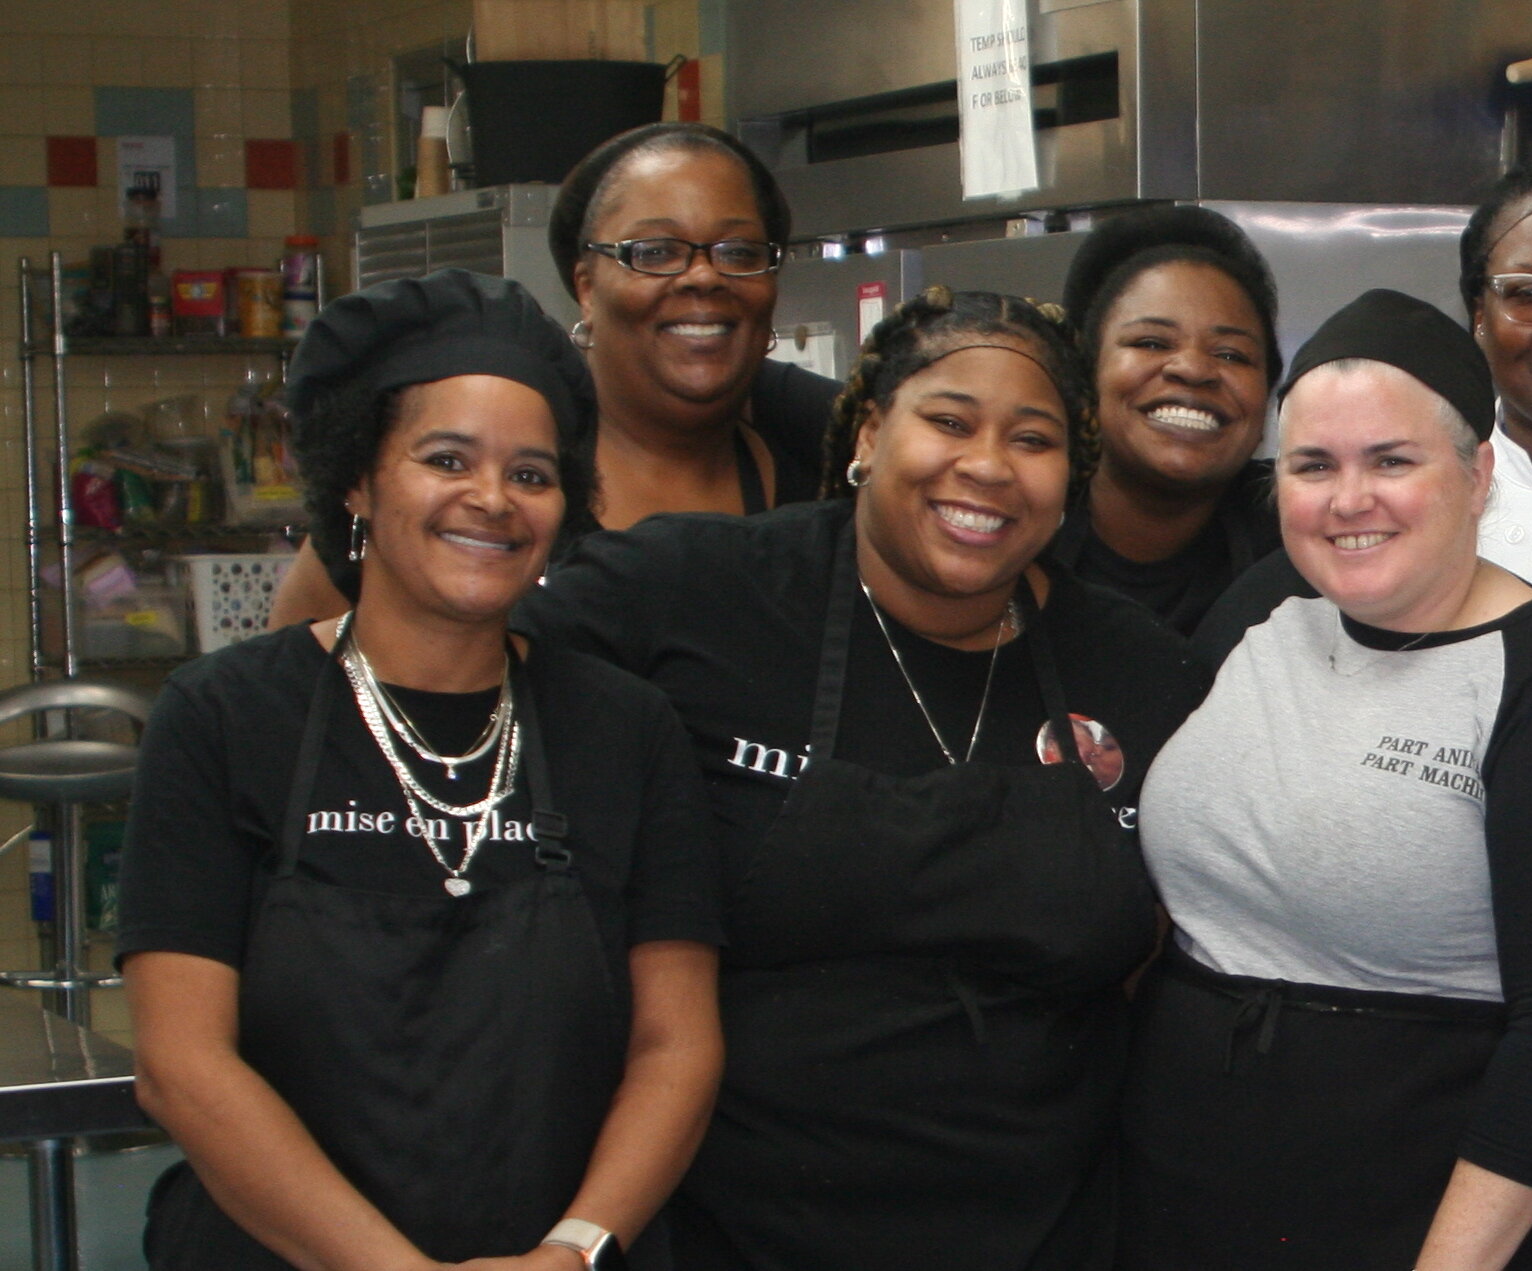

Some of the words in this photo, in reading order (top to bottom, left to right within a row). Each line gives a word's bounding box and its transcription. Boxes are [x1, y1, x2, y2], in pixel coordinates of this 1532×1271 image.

[970, 34, 996, 52] TEMP
[971, 60, 1007, 80] ALWAYS
[972, 94, 979, 109] F
[980, 91, 993, 107] OR
[1377, 736, 1428, 756] PART
[1360, 753, 1414, 775] PART
[306, 800, 396, 835] mise
[405, 816, 451, 841] en
